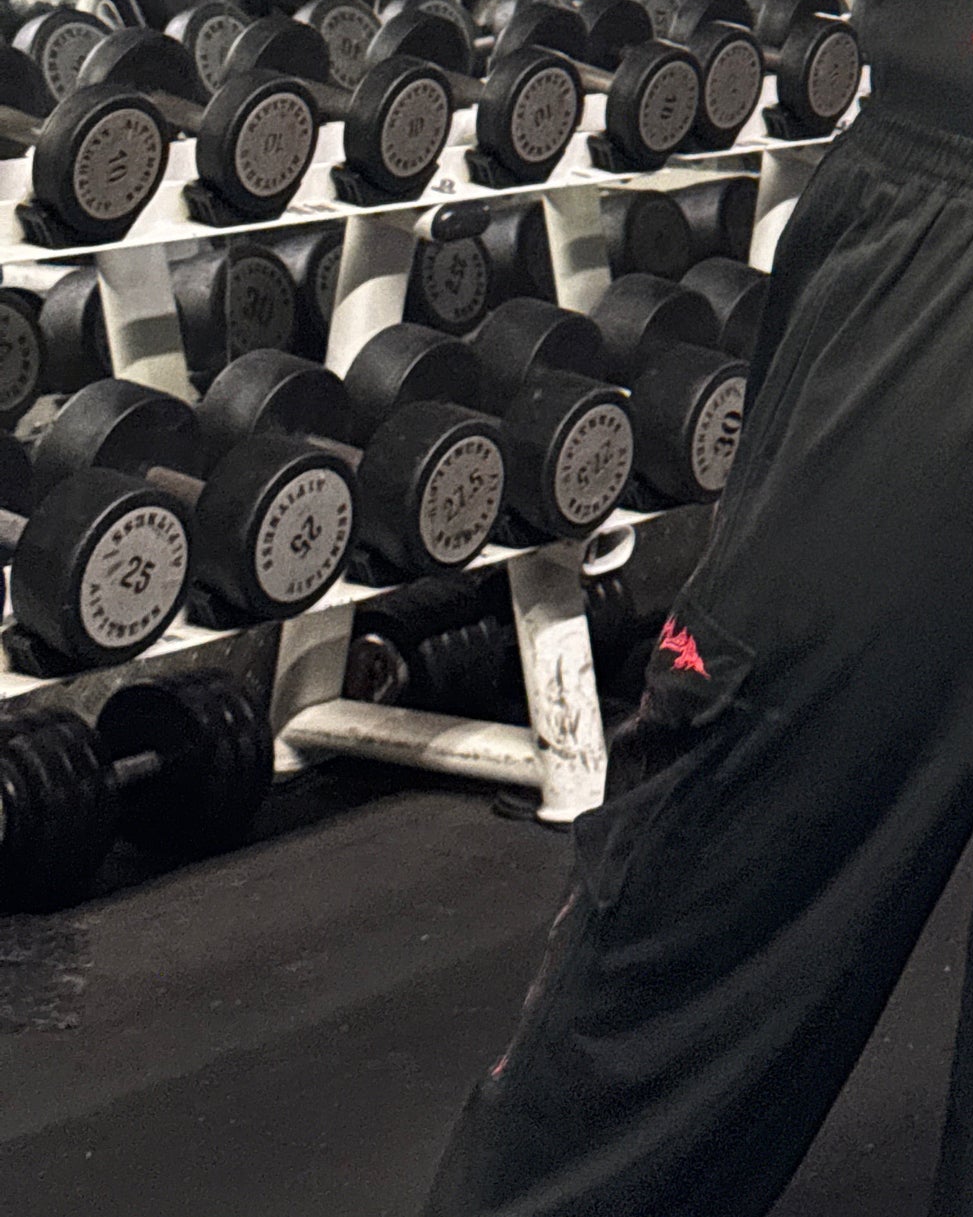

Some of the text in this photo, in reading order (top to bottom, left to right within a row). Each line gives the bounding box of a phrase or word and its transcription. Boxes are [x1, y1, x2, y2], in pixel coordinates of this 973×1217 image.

[107, 148, 128, 183] 10
[290, 515, 322, 559] 25
[119, 555, 156, 595] 25
